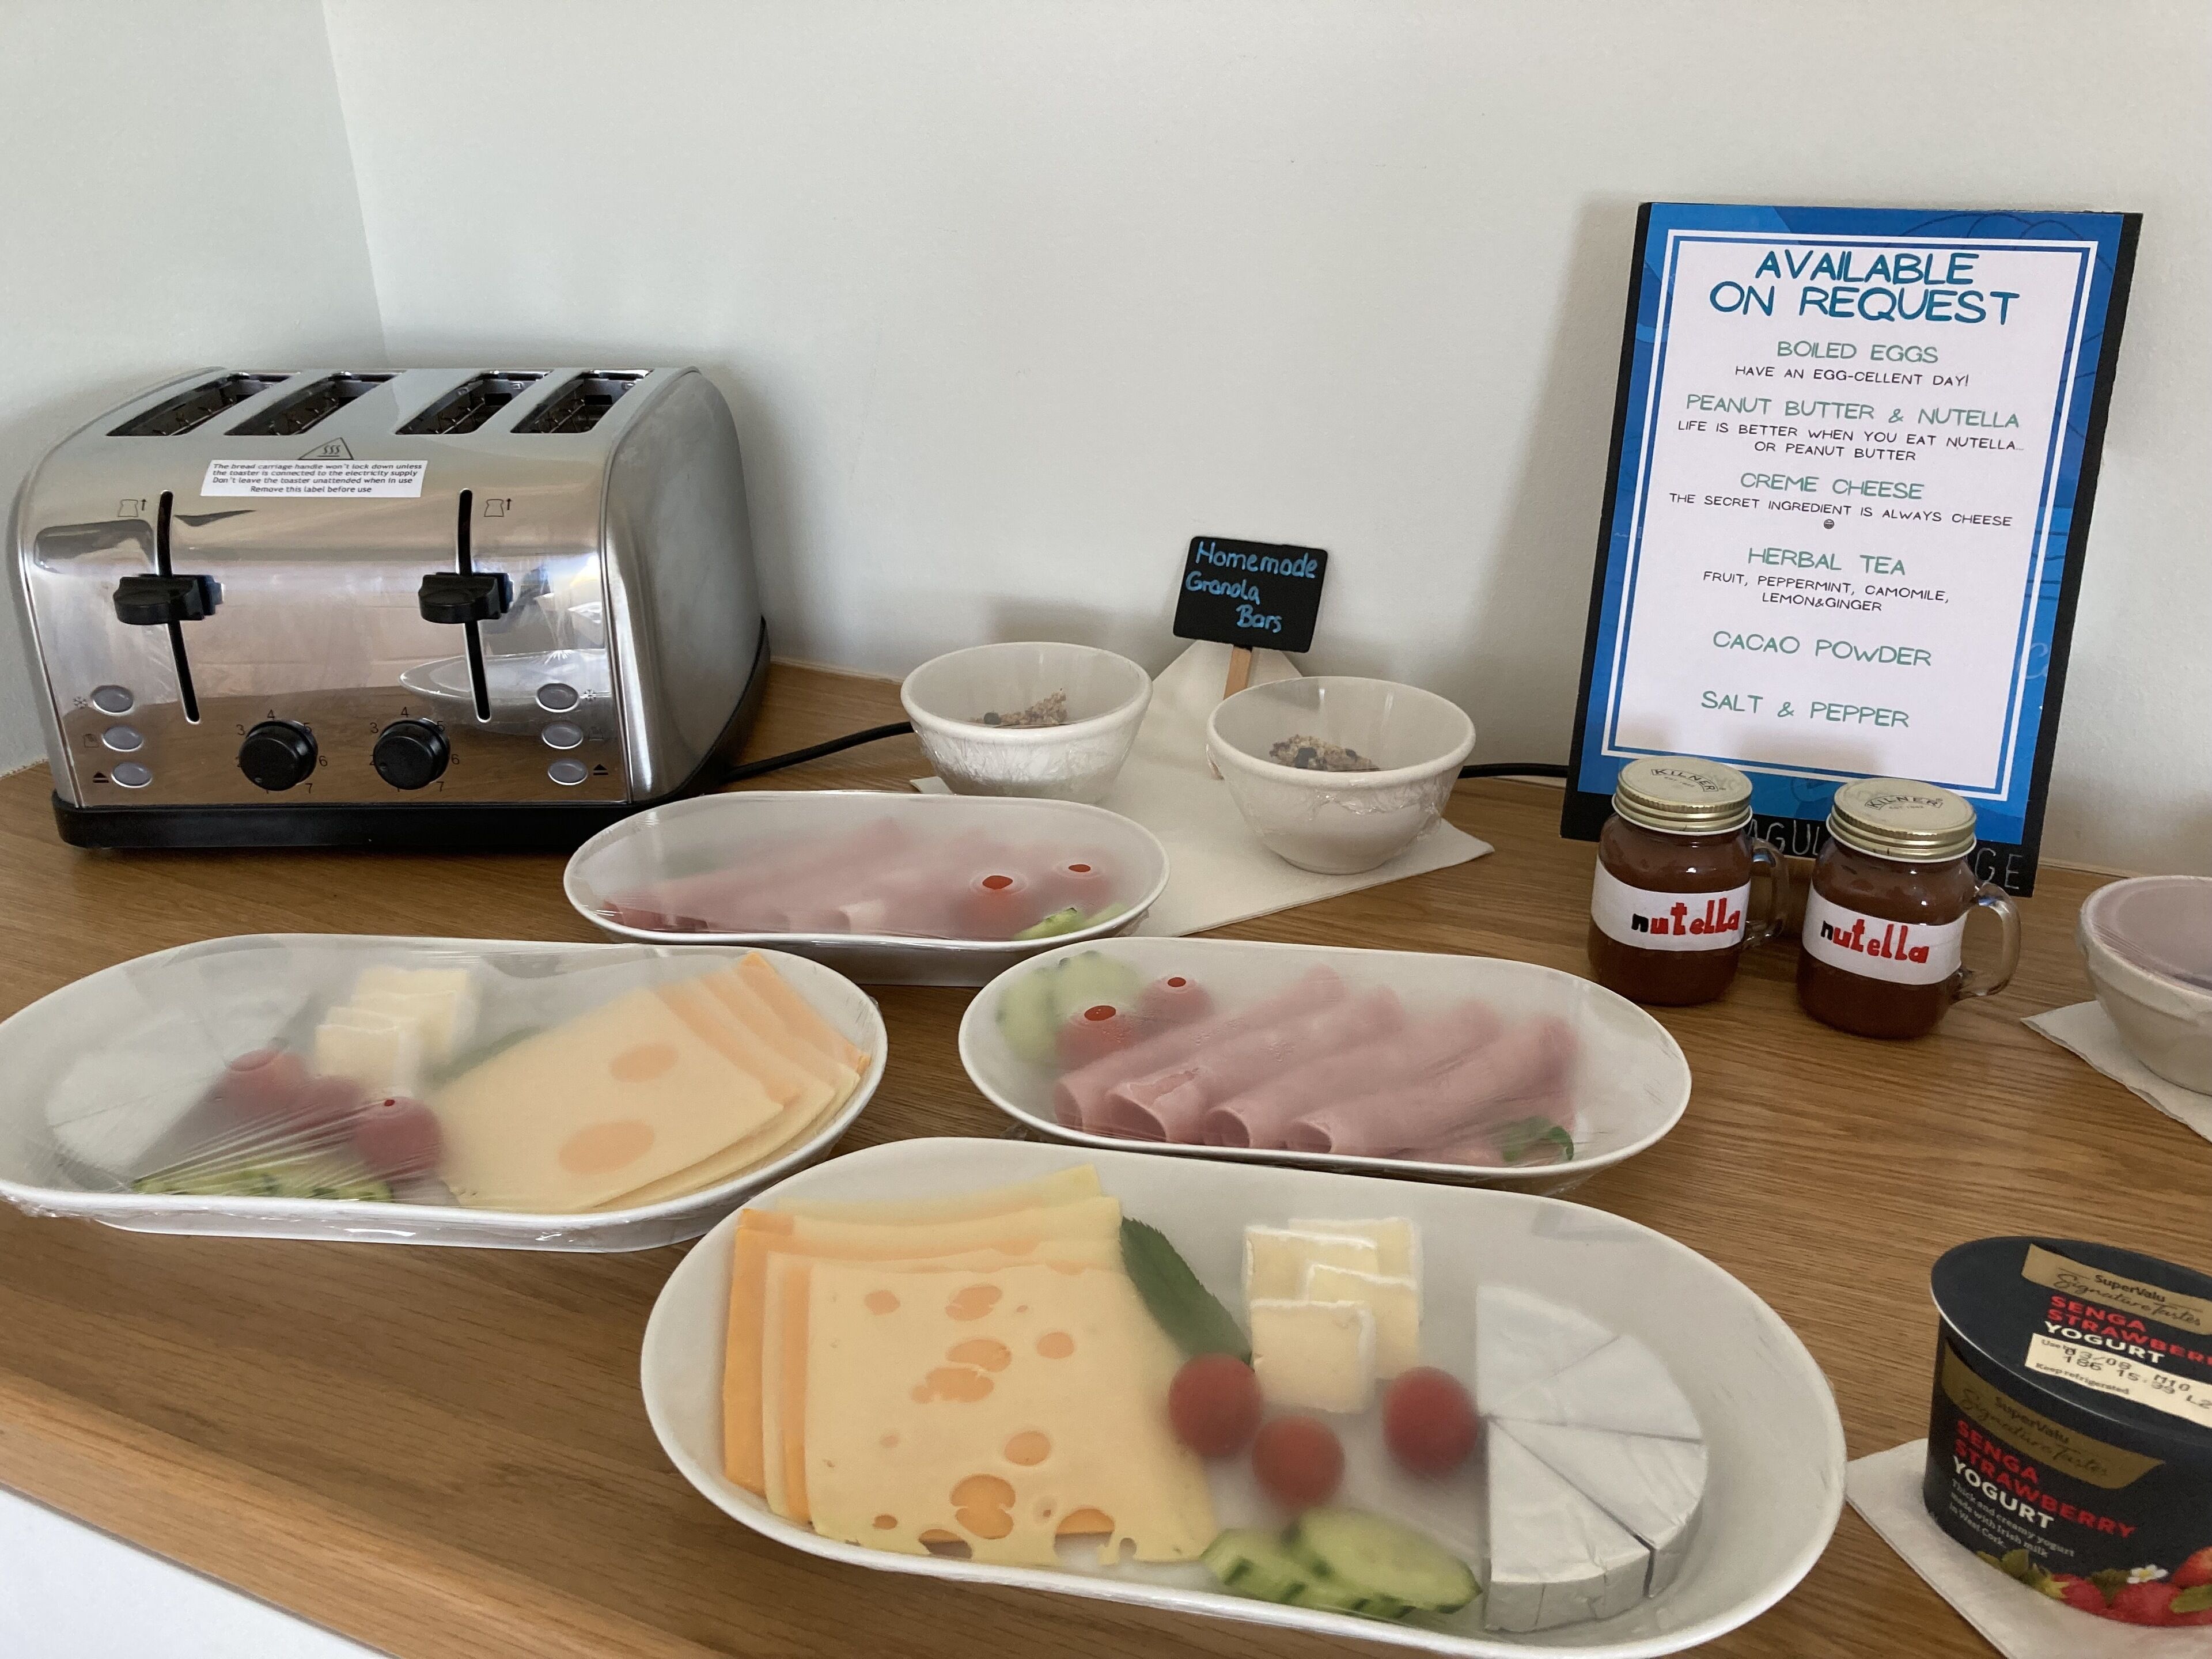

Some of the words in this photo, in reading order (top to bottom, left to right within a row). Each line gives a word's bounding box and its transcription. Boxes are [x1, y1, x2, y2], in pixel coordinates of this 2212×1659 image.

[1755, 249, 1979, 286] AVAILABLE
[1710, 281, 1775, 316] ON
[1798, 287, 2020, 325] REQUEST
[1777, 340, 1857, 360] BOILED
[1870, 344, 1939, 364] EGGS
[1734, 366, 1775, 378] HAVE
[1784, 368, 1805, 379] AN
[1812, 370, 1923, 385] EGG-CELLENT
[1933, 374, 1969, 387] DAY!
[1686, 394, 1772, 415] PEANUT
[1785, 401, 1875, 421] BUTTER
[1889, 408, 1904, 423] &
[1918, 408, 2020, 429] NUTELLA
[1677, 421, 1707, 432] LIFE
[1716, 422, 1729, 433] IS
[1738, 424, 1798, 438] BETTER
[1808, 428, 1854, 442] WHEN
[1863, 431, 1897, 444] YOU
[1907, 434, 1937, 446] EAT
[1754, 441, 1776, 452] OR
[1785, 442, 1844, 459] PEANUT
[1854, 447, 1916, 461] BUTTER
[1740, 472, 1818, 493] CREME
[1832, 479, 1925, 500] CHEESE
[1669, 493, 1696, 505] THE
[1703, 495, 1760, 510] SECRET
[1768, 501, 1852, 517] INGREDIENT
[1861, 506, 1873, 517] IS
[1882, 509, 1942, 522] ALWAYS
[1952, 513, 2013, 527] CHEESE
[1195, 541, 1319, 579] Homemade
[1748, 547, 1842, 572] HERBAL
[1860, 555, 1906, 576] TEA
[1185, 570, 1261, 605] Granola
[1703, 571, 1748, 586] FRUIT,
[1758, 575, 1855, 596] PEPPERMINT,
[1865, 585, 1950, 604] CAMOMILE,
[1762, 592, 1883, 612] LEMON&GINGER
[1235, 604, 1283, 634] Bars
[1713, 631, 1800, 654] CACAO
[1815, 640, 1932, 668] POWDER
[267, 709, 275, 721] 4
[400, 706, 410, 718] 4
[1701, 691, 1763, 715] SALT
[1778, 701, 1794, 718] &
[1810, 702, 1910, 728] PEPPER
[236, 724, 245, 736] 3
[369, 722, 379, 734] 3
[319, 755, 328, 767] 6
[450, 753, 460, 765] 6
[304, 783, 313, 794] 7
[436, 781, 445, 793] 7
[1654, 768, 1716, 791] KILNER
[1867, 796, 1938, 808] KILNER
[1631, 897, 1741, 936] nutella
[1820, 918, 1930, 964] nutella
[2094, 1274, 2165, 1303] SuperValu
[2051, 1296, 2147, 1332] SENGA
[2041, 1339, 2061, 1349] Use
[2044, 1321, 2165, 1364] YOGURT
[2036, 1362, 2063, 1374] Keep
[2065, 1370, 2130, 1395] refrigerated
[1957, 1419, 2039, 1484] SENGA
[1953, 1455, 2055, 1529] YOGURT
[1955, 1439, 2138, 1539] STRAWBERRY
[1973, 1510, 1996, 1529] with
[2023, 1541, 2048, 1558] milk
[1976, 1501, 1995, 1517] and
[1996, 1514, 2036, 1539] creamy
[2036, 1535, 2075, 1557] yogurt
